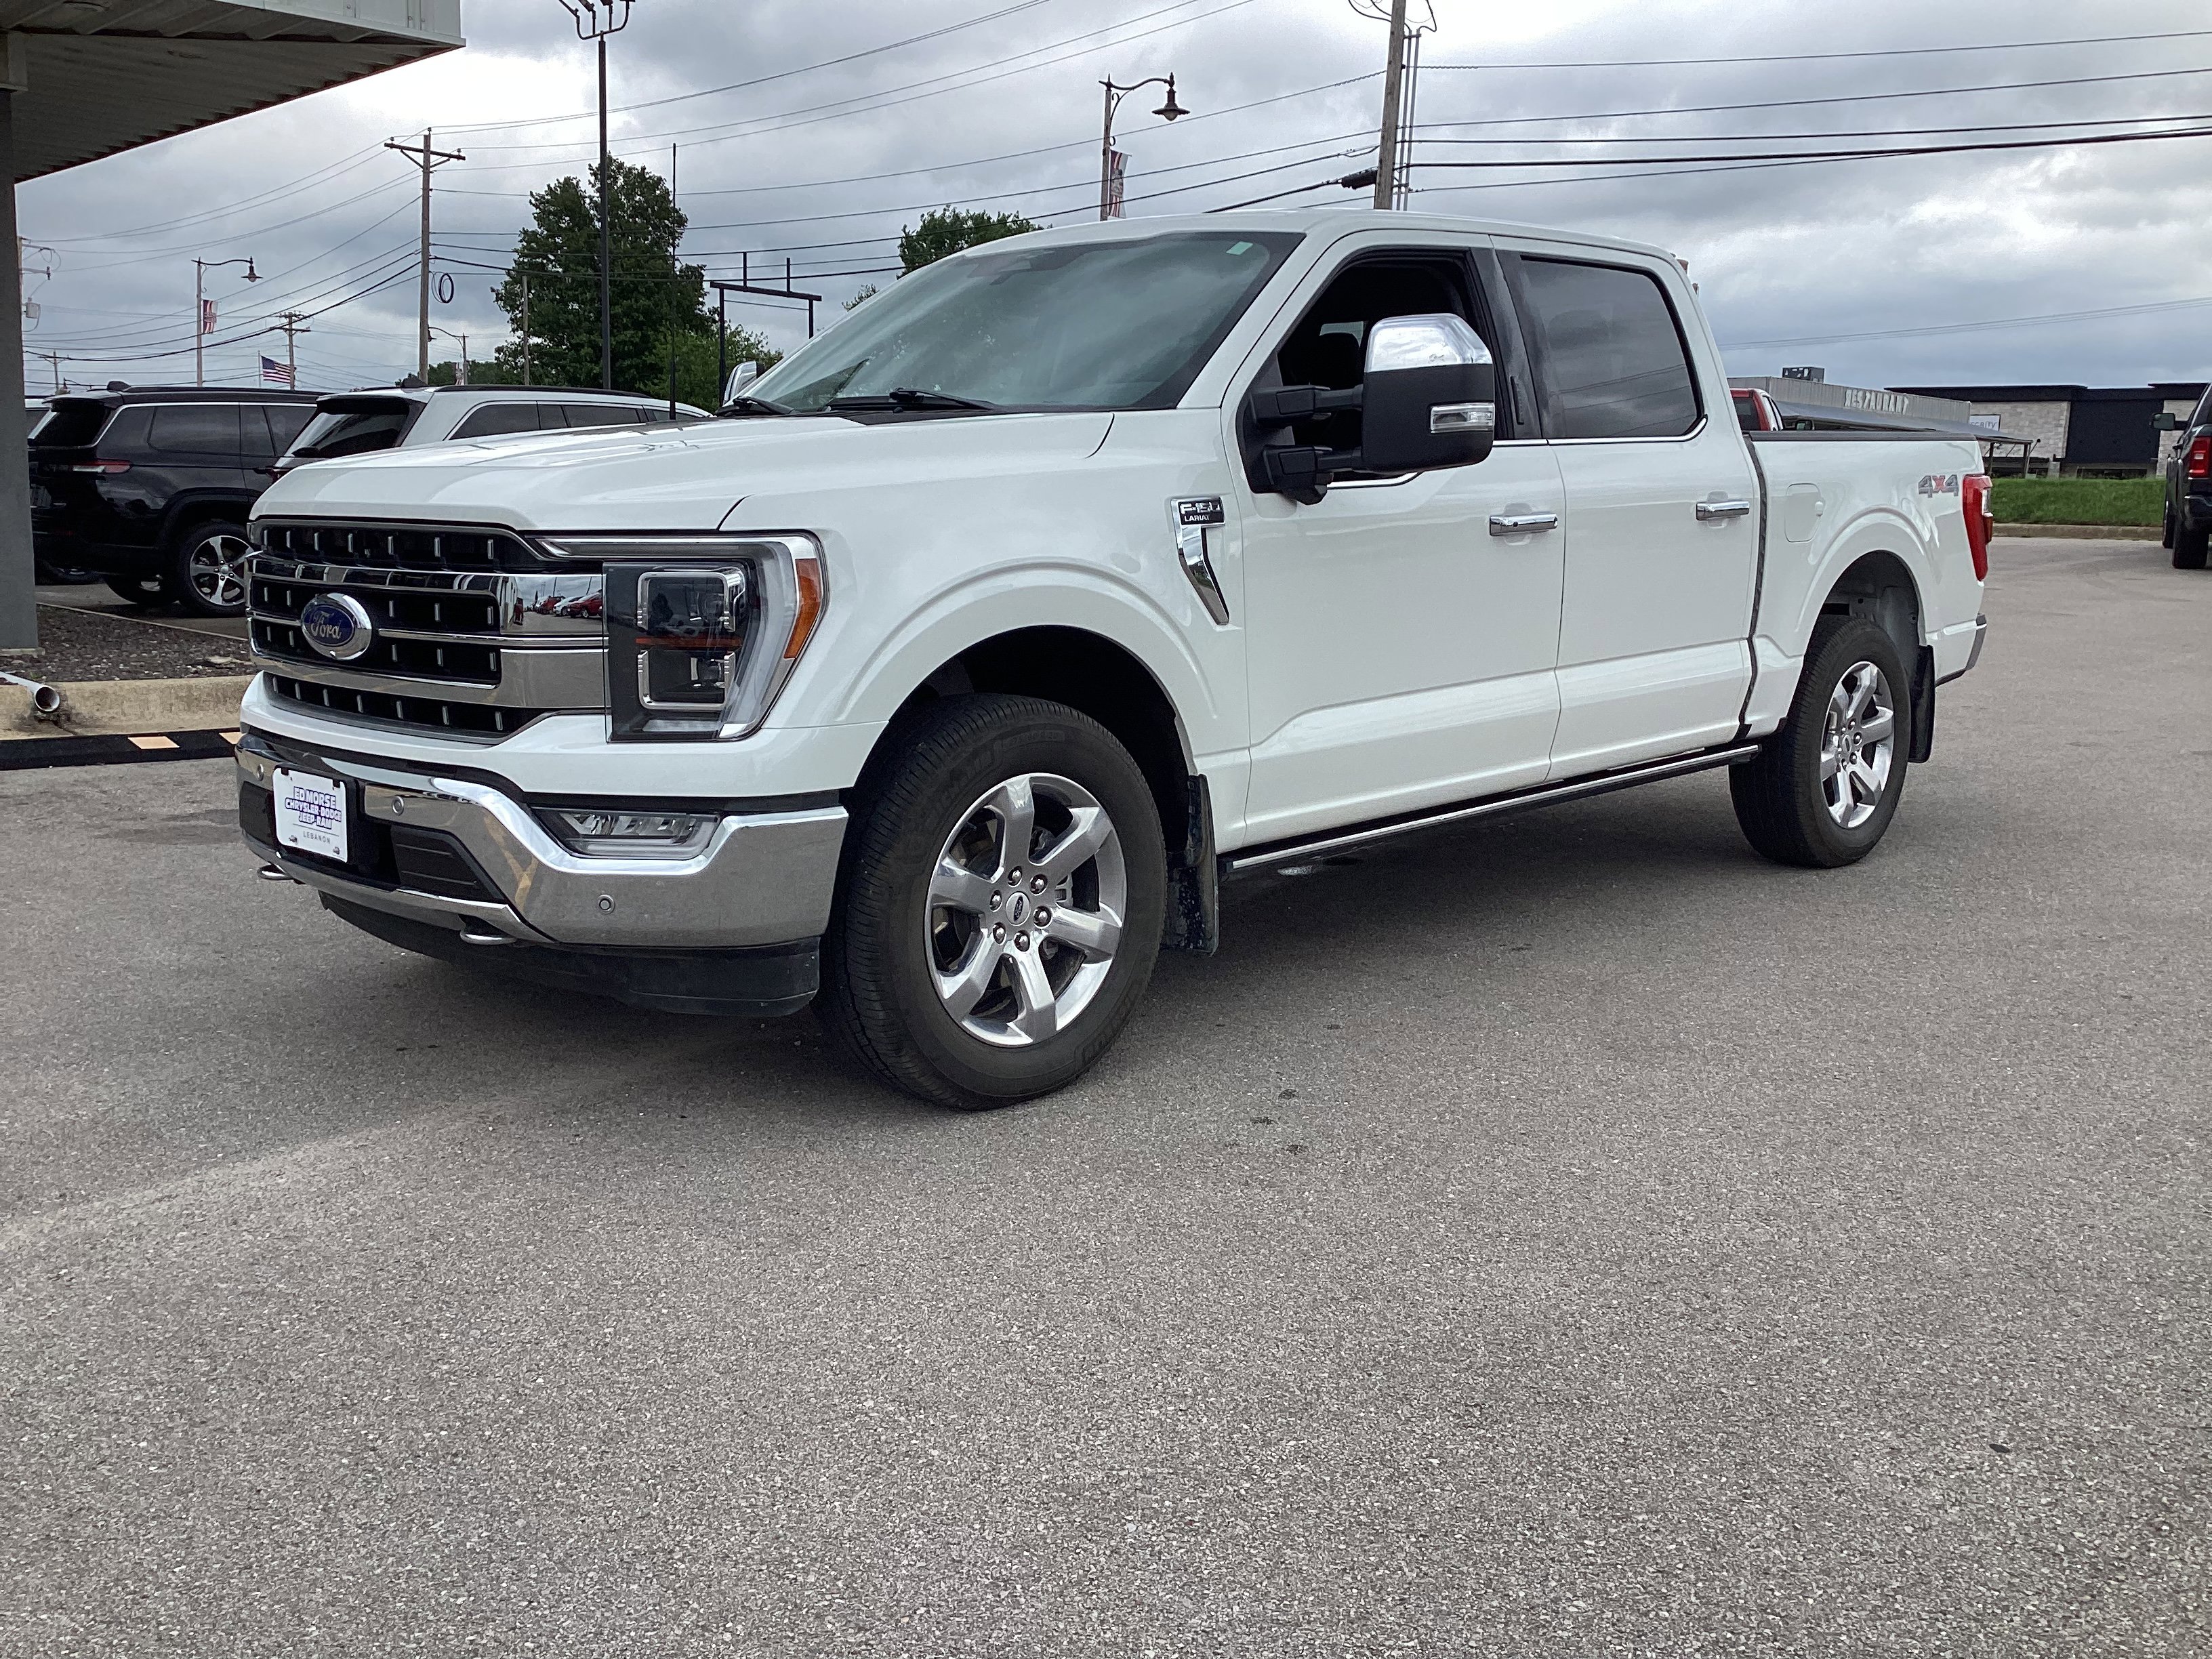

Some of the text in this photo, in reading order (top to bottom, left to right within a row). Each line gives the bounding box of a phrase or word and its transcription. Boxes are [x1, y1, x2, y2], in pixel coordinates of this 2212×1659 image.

[1844, 389, 1909, 415] RESTAURANT
[310, 610, 342, 639] Ford
[293, 786, 336, 809] ED MORSE
[303, 832, 330, 844] LEBANON
